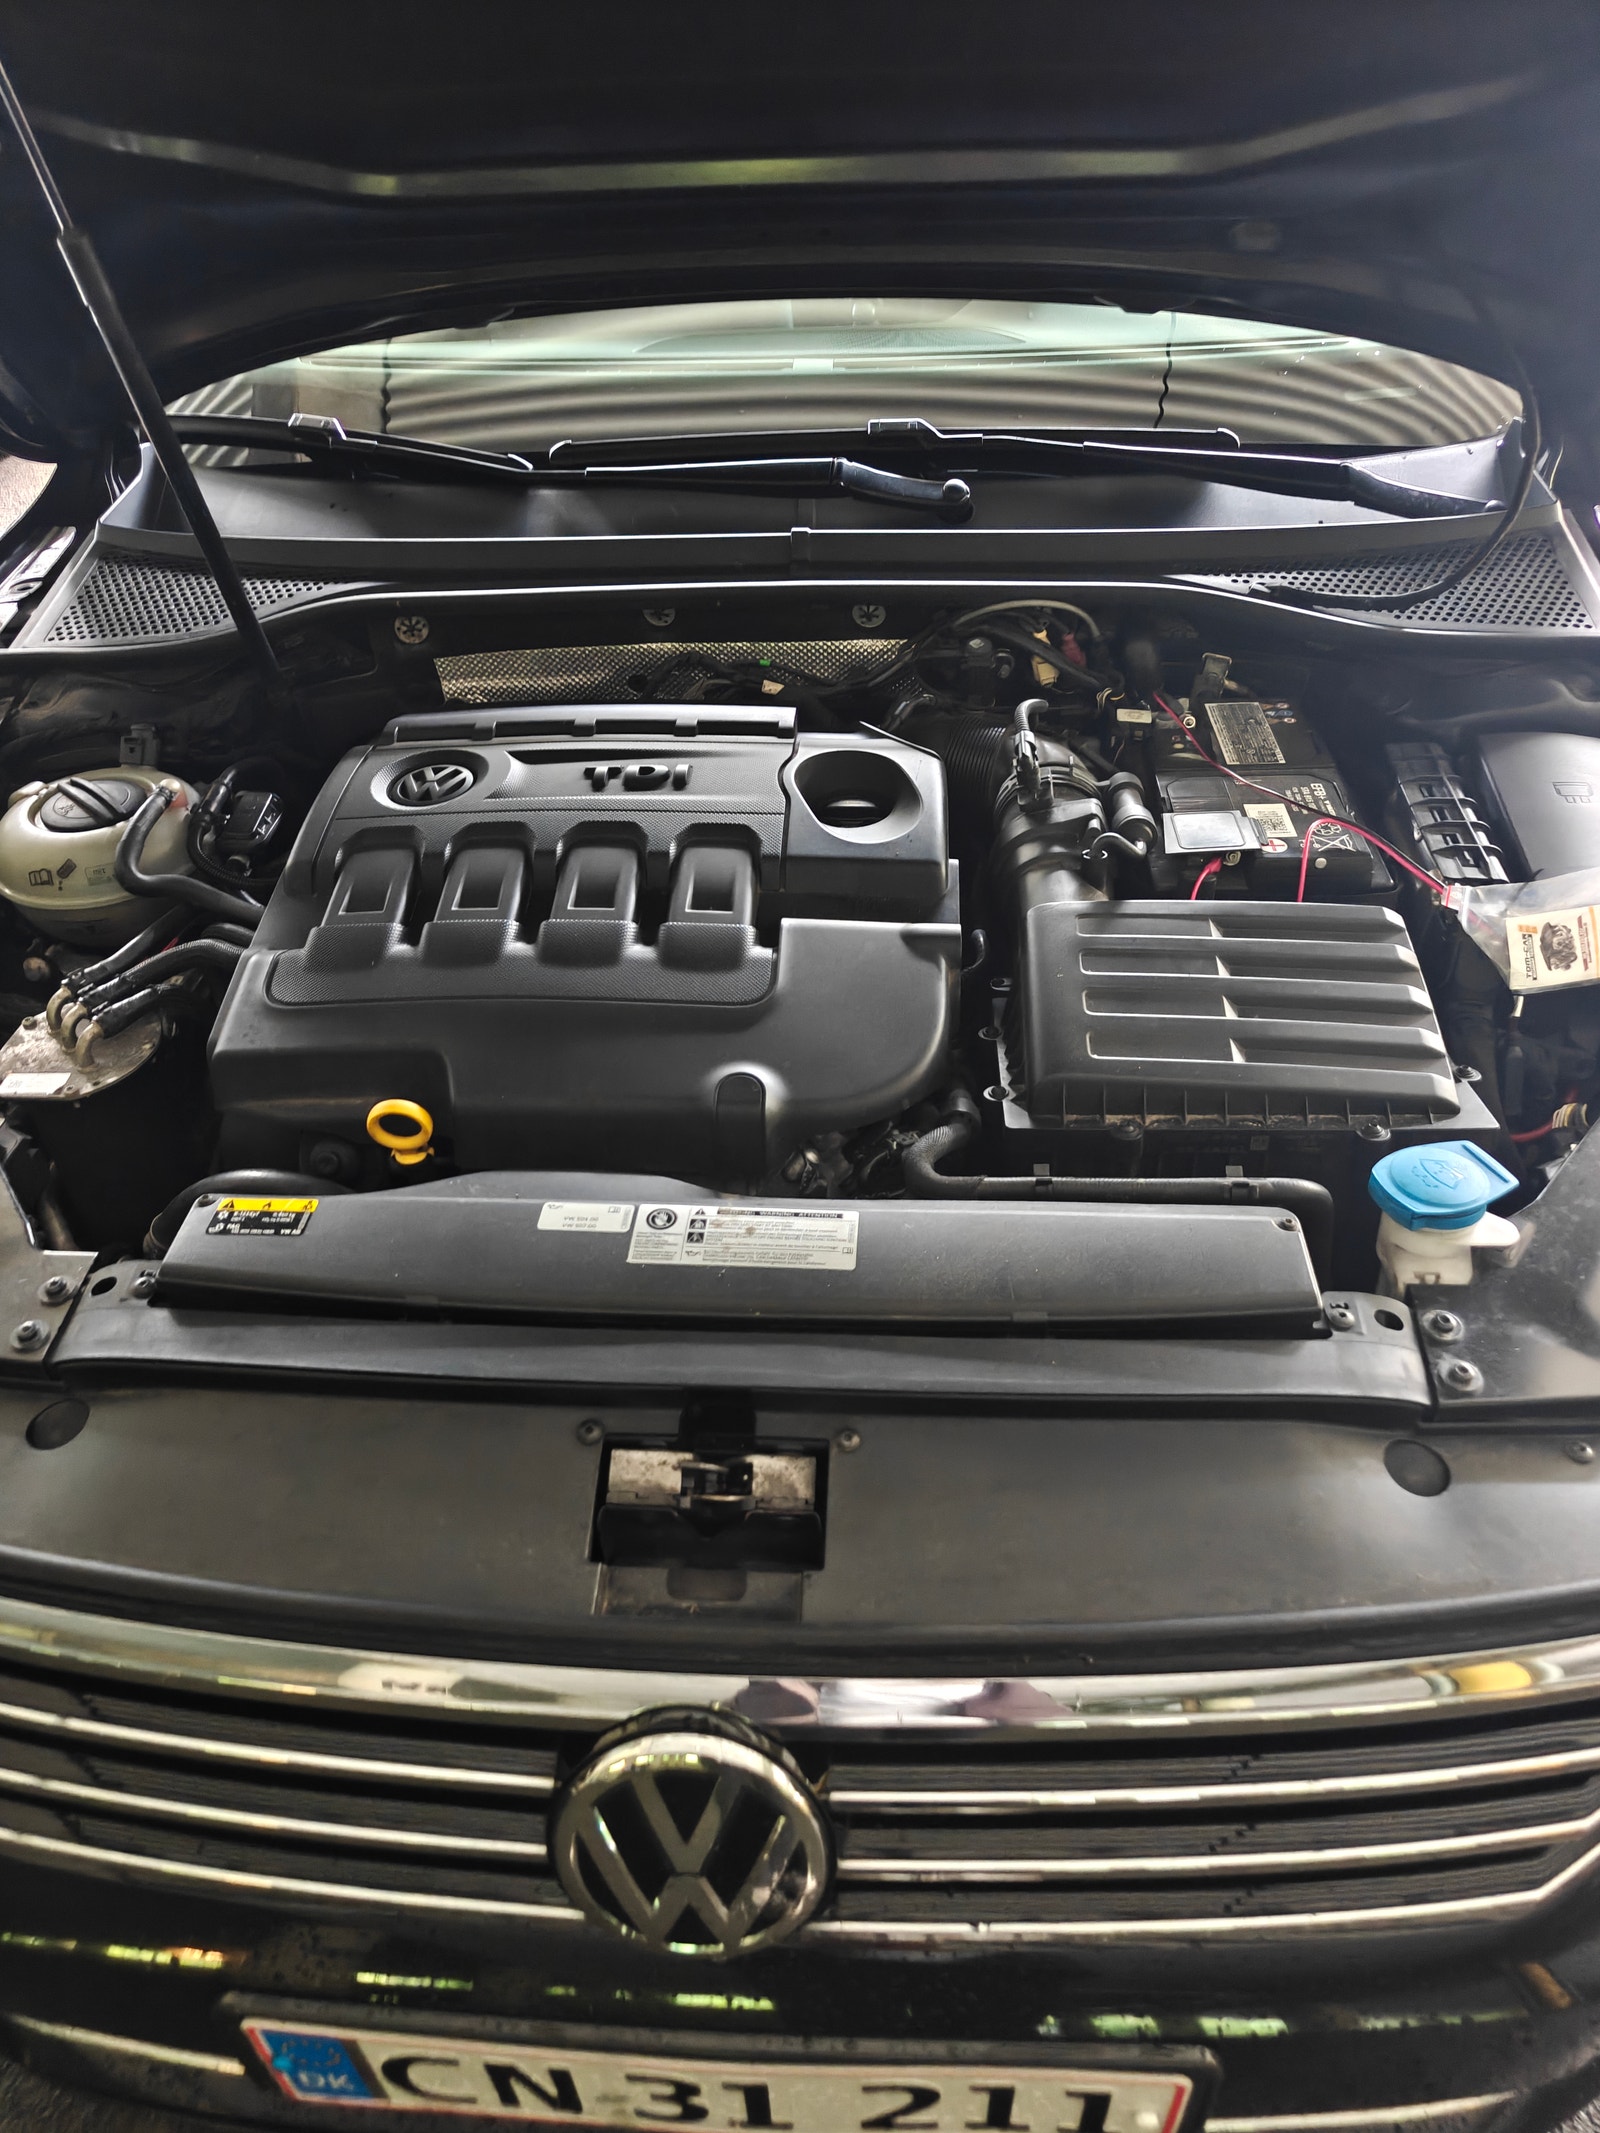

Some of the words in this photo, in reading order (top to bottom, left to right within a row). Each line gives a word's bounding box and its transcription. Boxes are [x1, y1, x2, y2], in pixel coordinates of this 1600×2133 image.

[584, 754, 693, 791] TDI
[562, 1740, 820, 1952] VW
[298, 2071, 355, 2090] DK
[381, 2055, 583, 2114] CN
[625, 2073, 794, 2131] 31
[860, 2085, 1123, 2133] 211
